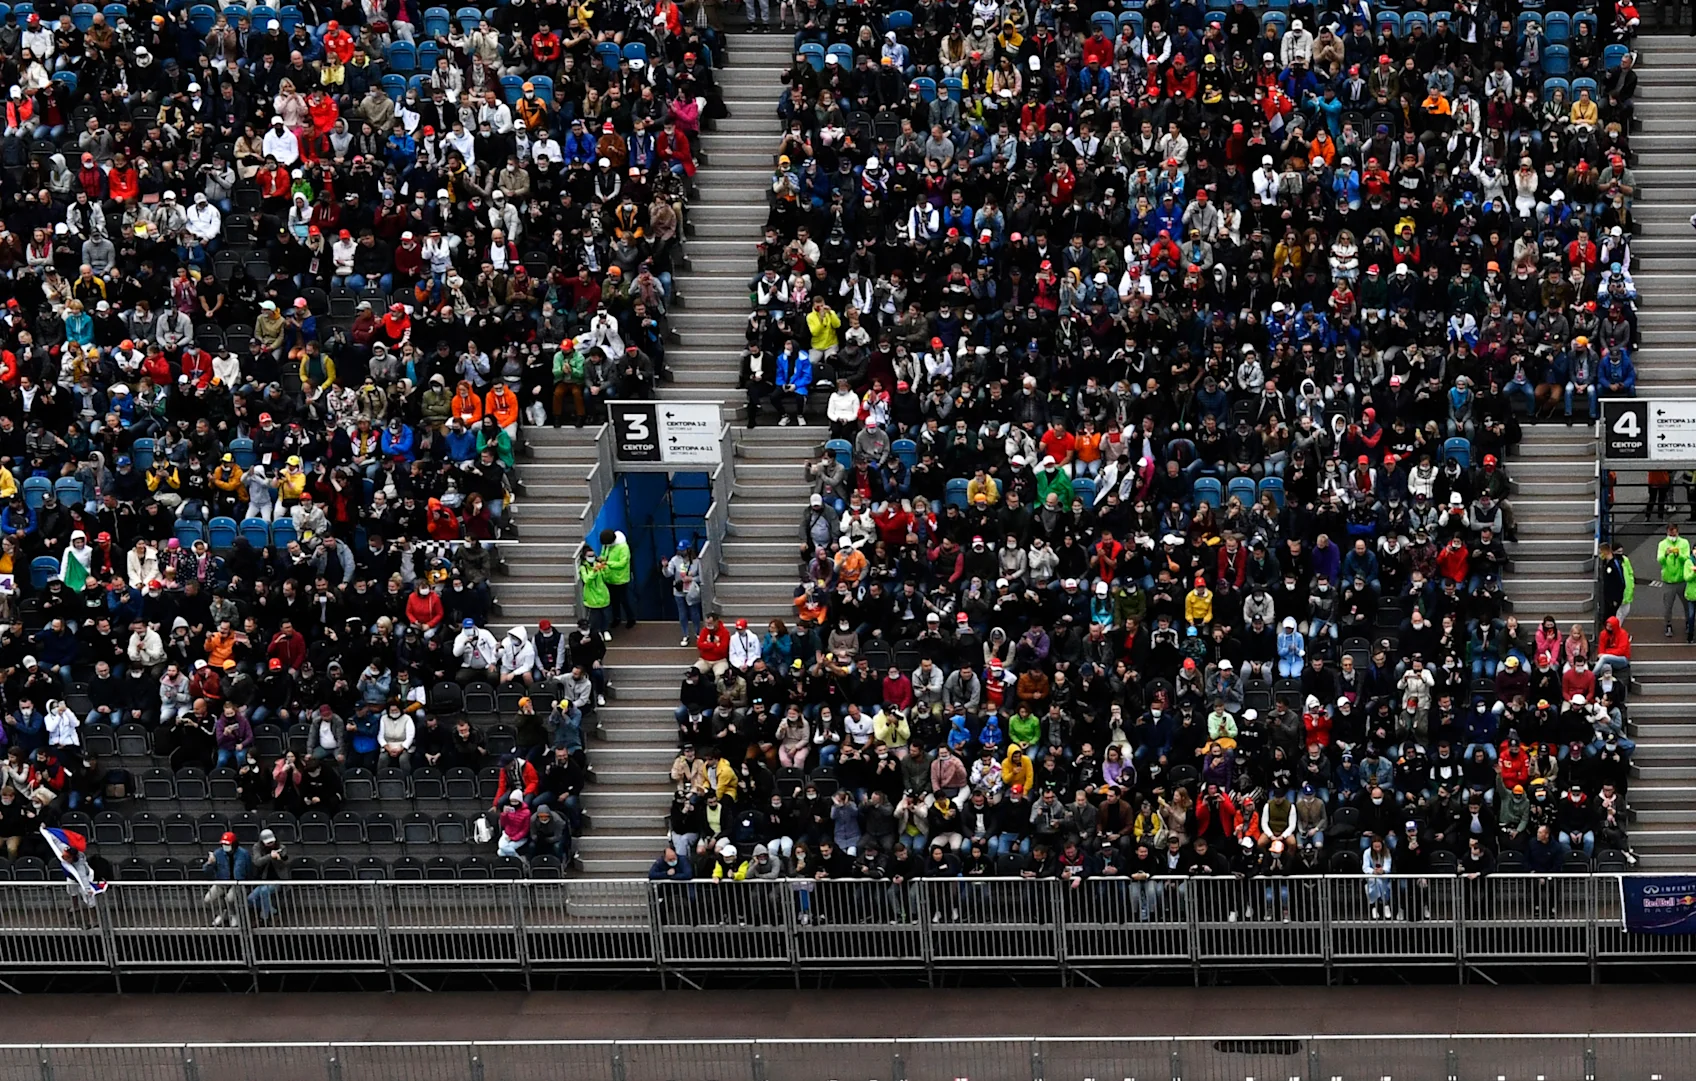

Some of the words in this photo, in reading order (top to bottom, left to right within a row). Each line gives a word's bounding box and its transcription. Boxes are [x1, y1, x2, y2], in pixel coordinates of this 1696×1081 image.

[623, 413, 649, 440] 3
[1612, 411, 1641, 438] 4
[1611, 441, 1643, 449] СЕКТОР
